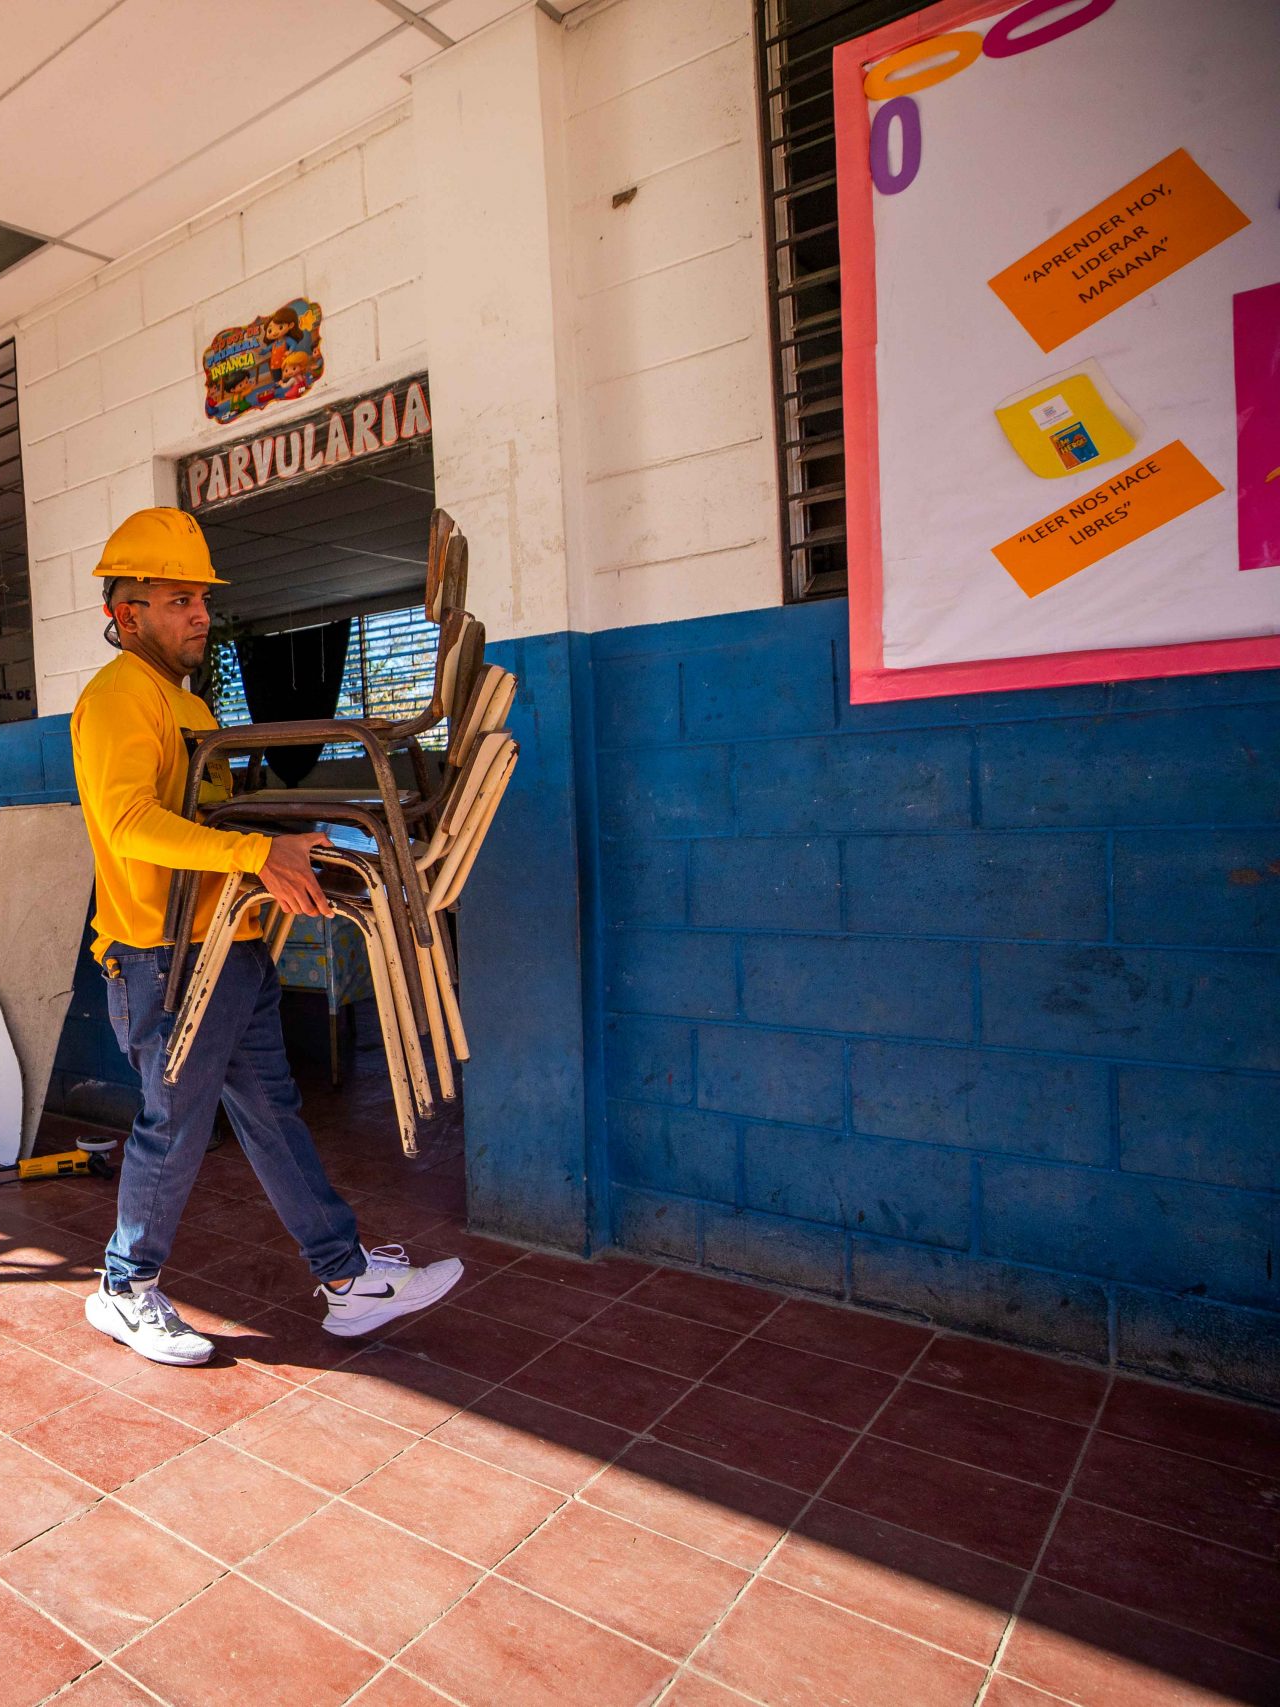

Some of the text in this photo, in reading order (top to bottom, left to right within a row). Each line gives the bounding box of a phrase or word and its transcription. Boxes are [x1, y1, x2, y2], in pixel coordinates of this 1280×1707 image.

[1023, 184, 1173, 283] “APRENDER HOY,
[1071, 225, 1149, 280] LIDERAR
[1078, 236, 1169, 304] MAÑANA”
[207, 336, 261, 367] PRIMERA
[210, 352, 256, 381] INFANCIA
[188, 382, 432, 508] PARVULARIA
[1019, 460, 1161, 545] “LEER NOS HACE
[1069, 501, 1132, 546] LIBRES”
[16, 689, 31, 701] DE
